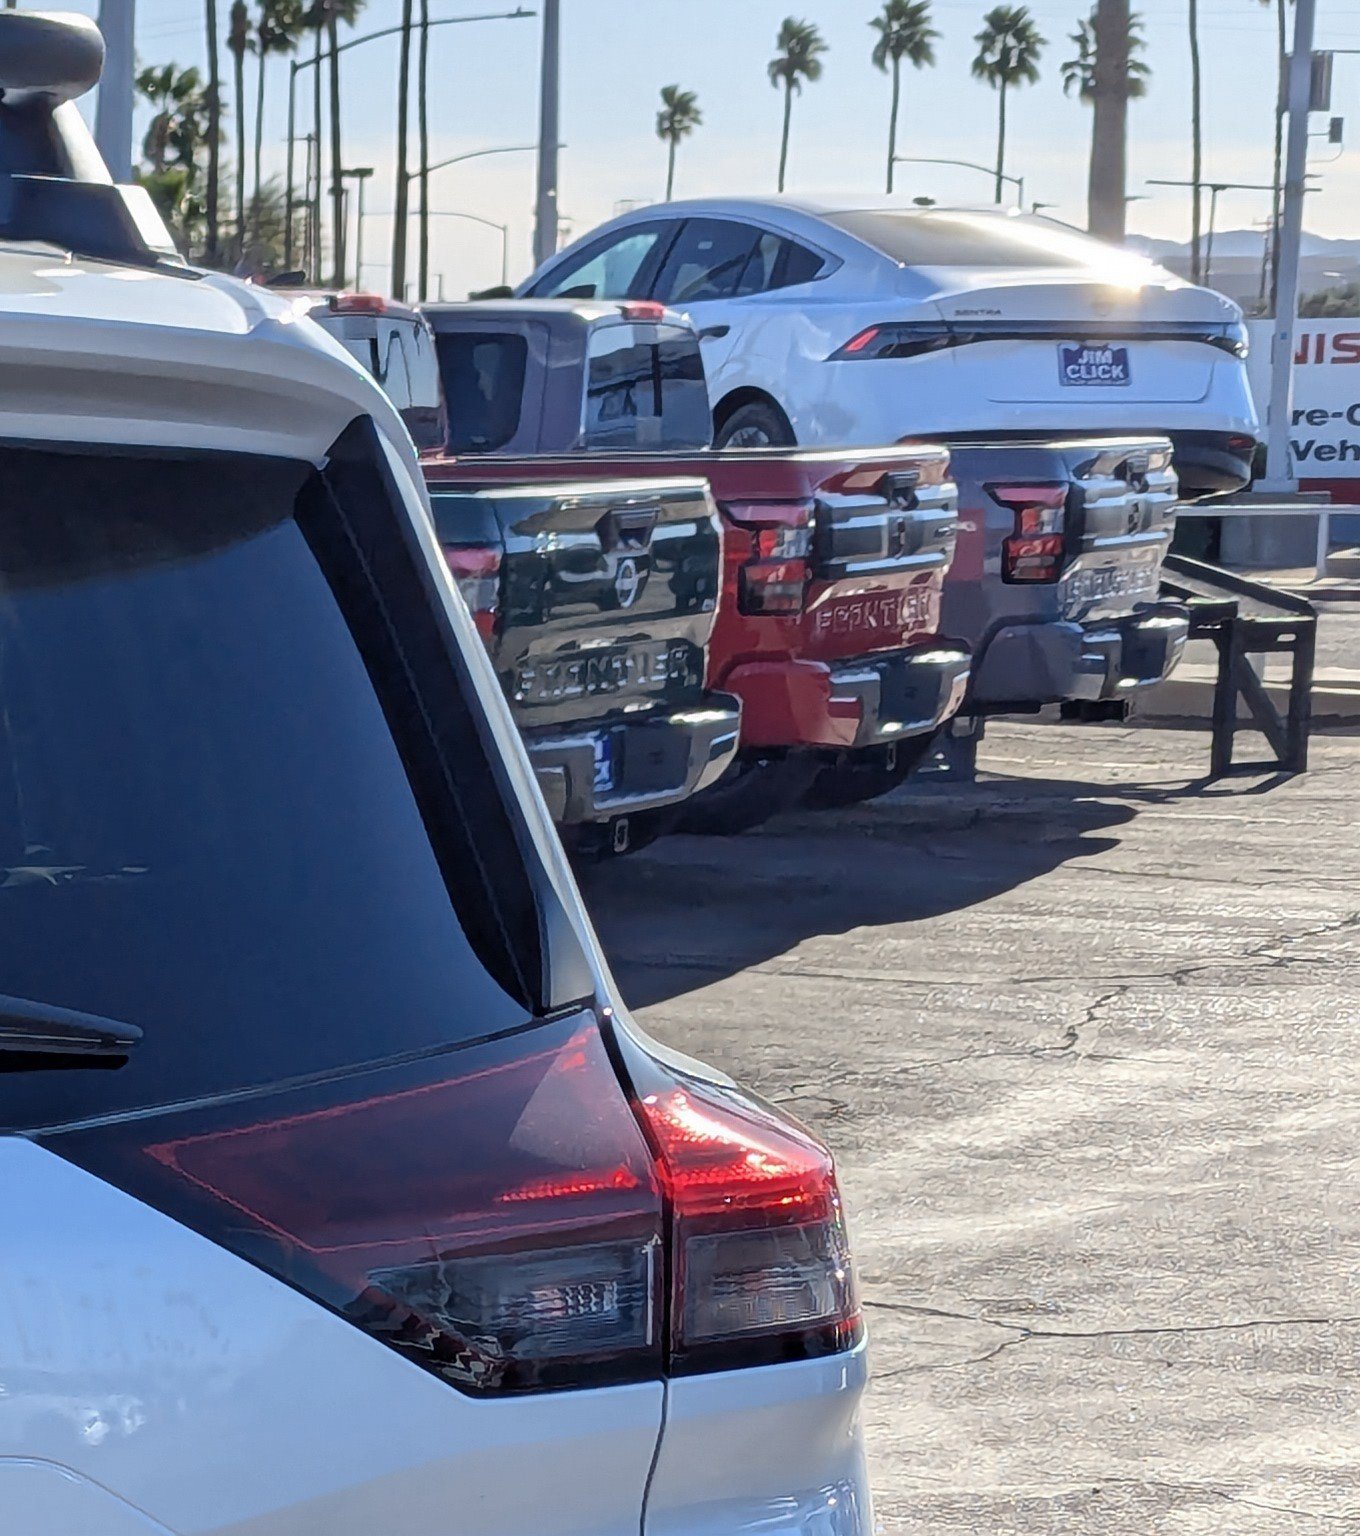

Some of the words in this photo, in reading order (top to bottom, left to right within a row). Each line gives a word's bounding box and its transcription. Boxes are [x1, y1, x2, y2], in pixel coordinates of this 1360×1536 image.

[1078, 350, 1113, 365] JIM
[1066, 365, 1125, 380] CLICK
[1267, 403, 1360, 427] re-
